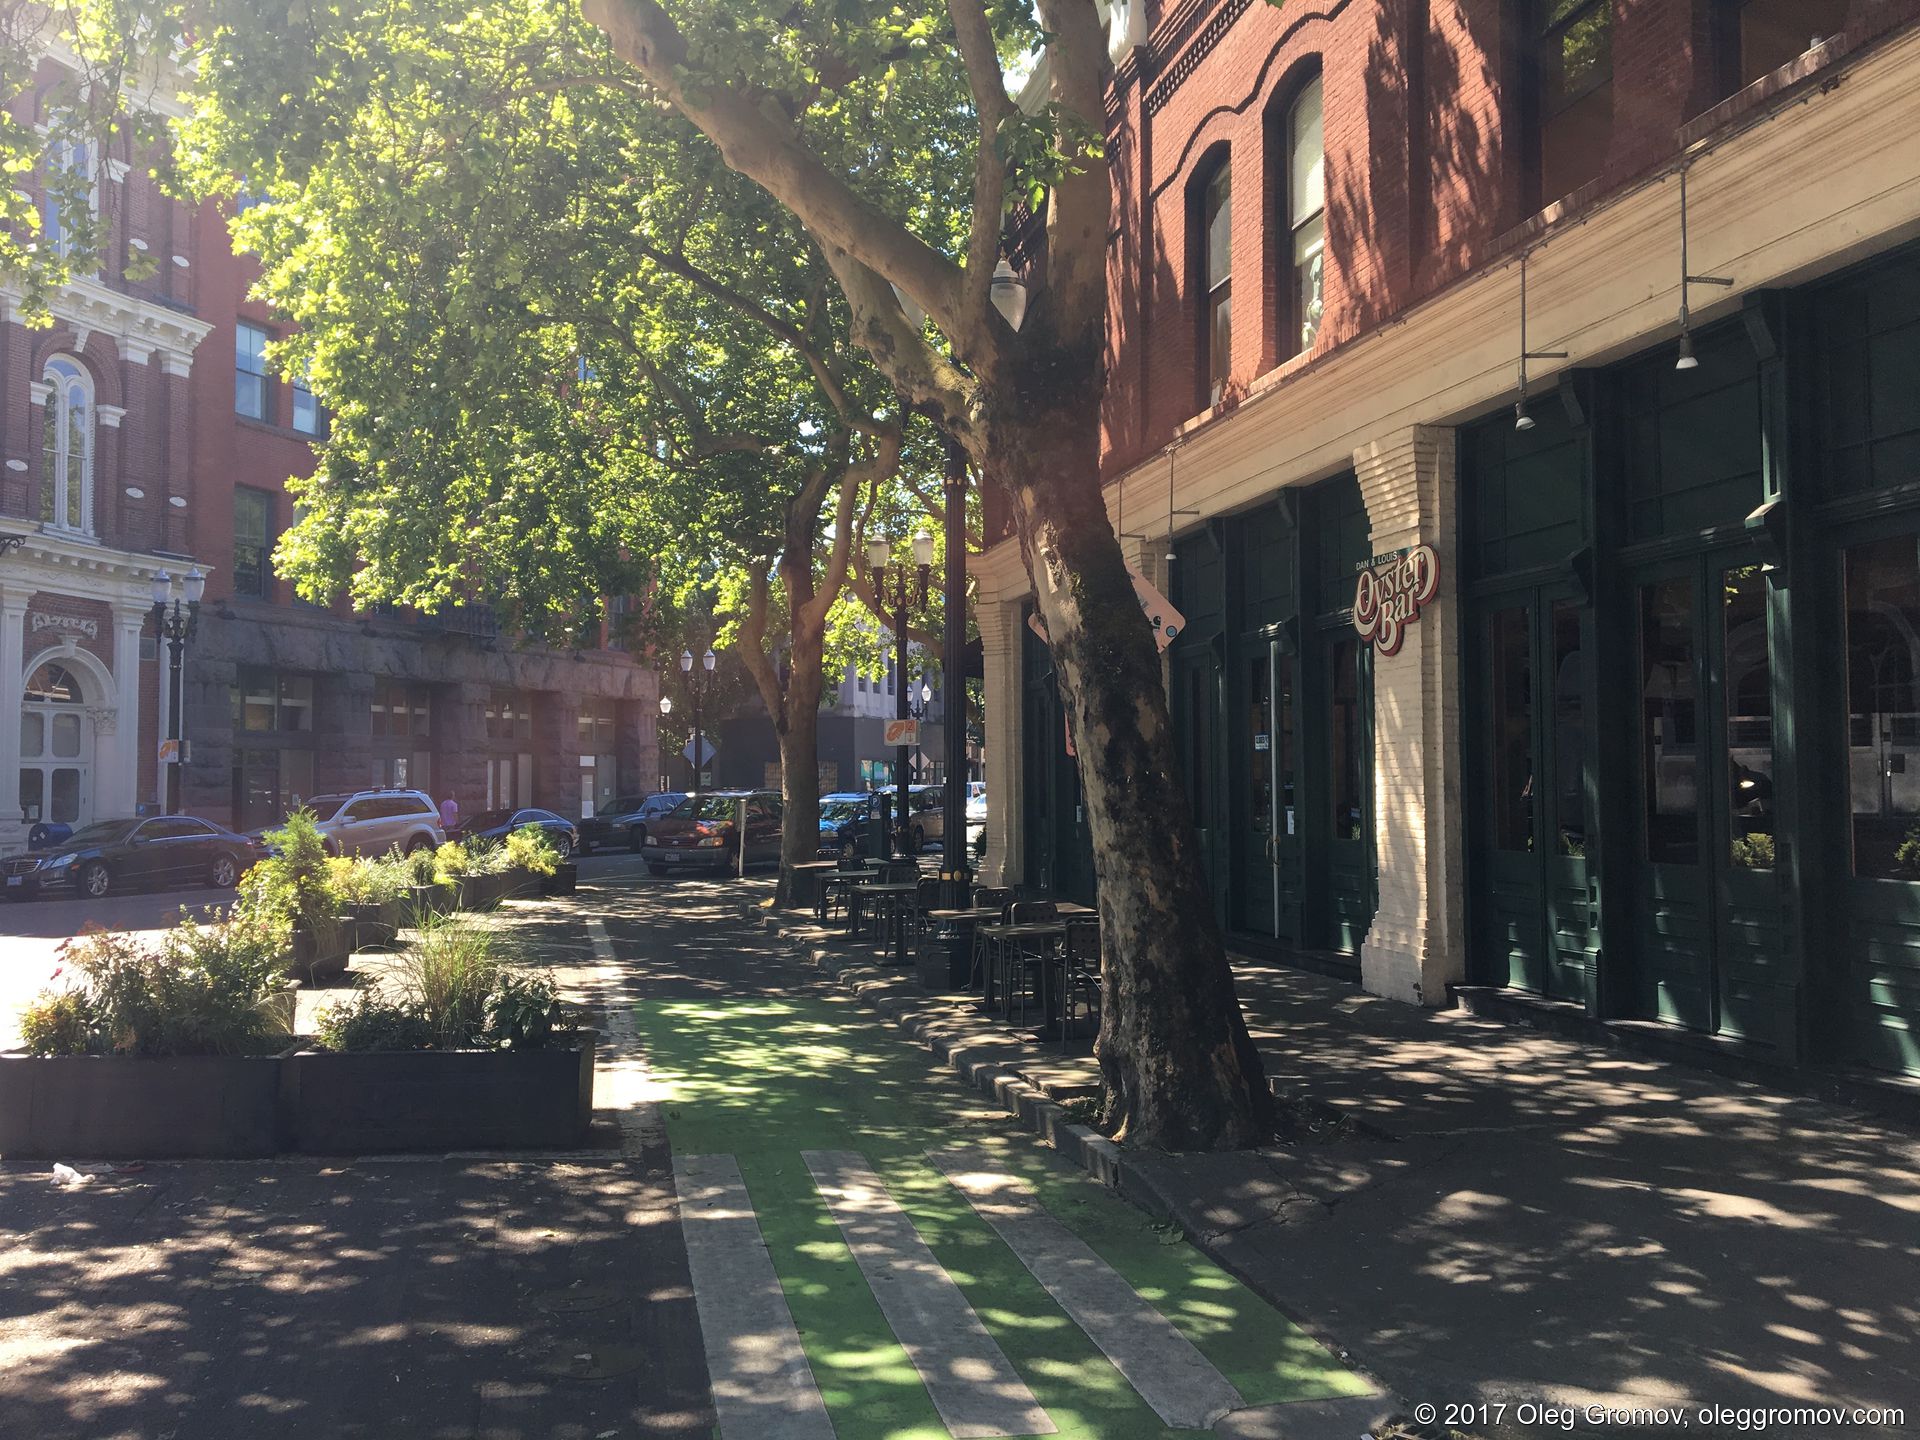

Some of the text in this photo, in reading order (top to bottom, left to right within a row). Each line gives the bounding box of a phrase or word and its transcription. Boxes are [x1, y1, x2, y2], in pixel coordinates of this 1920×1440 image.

[1354, 545, 1436, 636] Oyster
[1355, 551, 1398, 570] DAN & LOUIS
[1376, 583, 1419, 651] Bar
